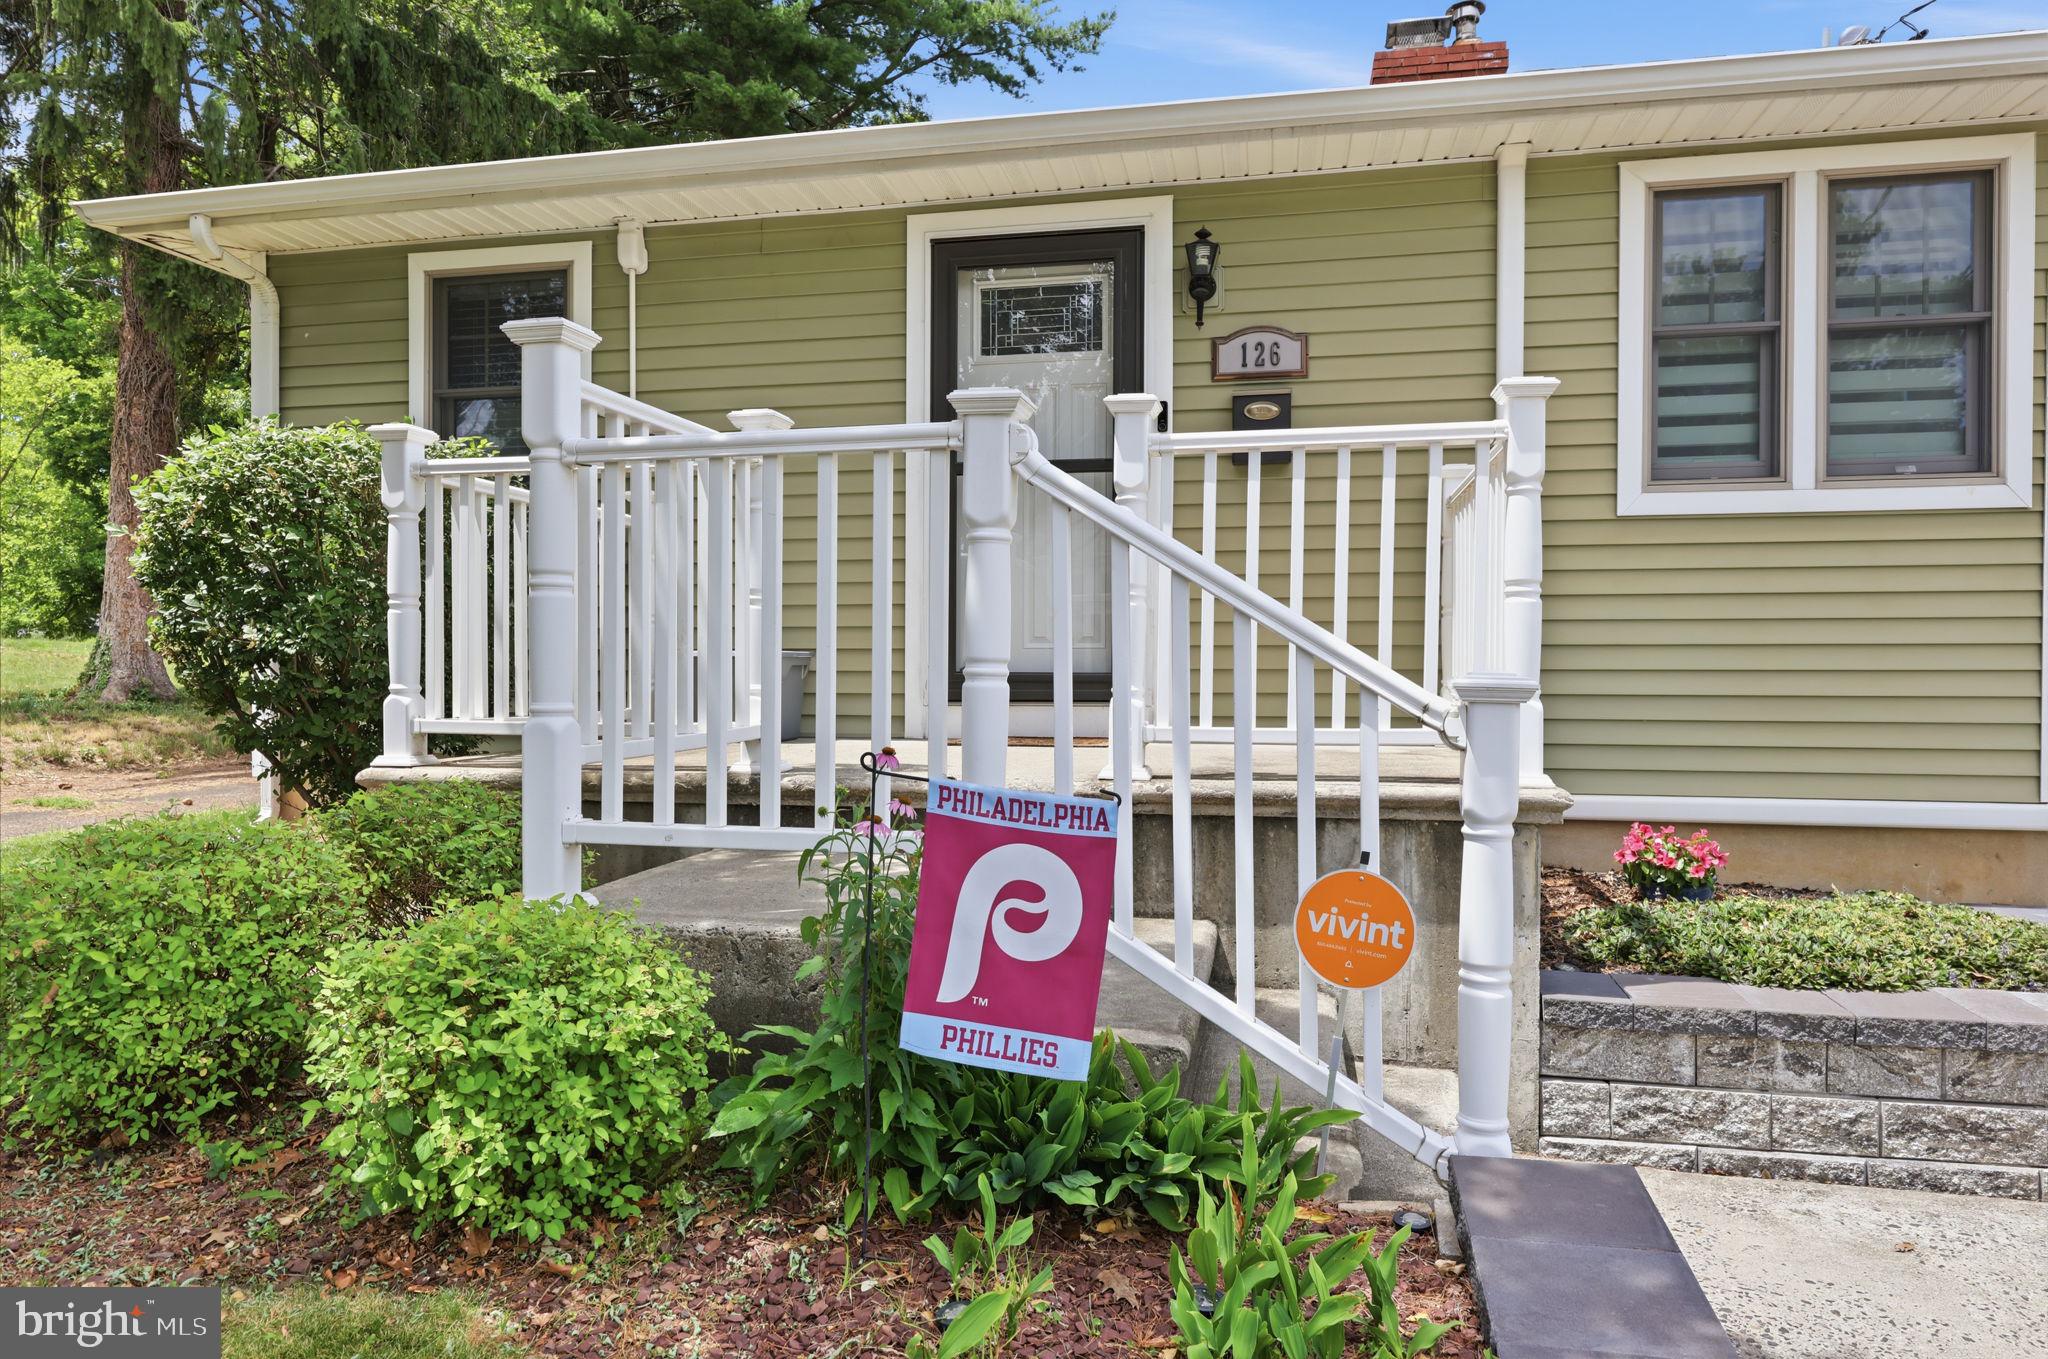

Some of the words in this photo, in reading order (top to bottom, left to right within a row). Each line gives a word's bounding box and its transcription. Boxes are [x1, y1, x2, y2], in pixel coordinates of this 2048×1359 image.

[1241, 341, 1280, 368] 126
[937, 784, 1110, 832] PHILADELPHIA
[936, 843, 1083, 1003] P
[1308, 906, 1405, 949] vivint
[972, 996, 988, 1007] TM
[940, 1024, 1059, 1068] PHILLIES
